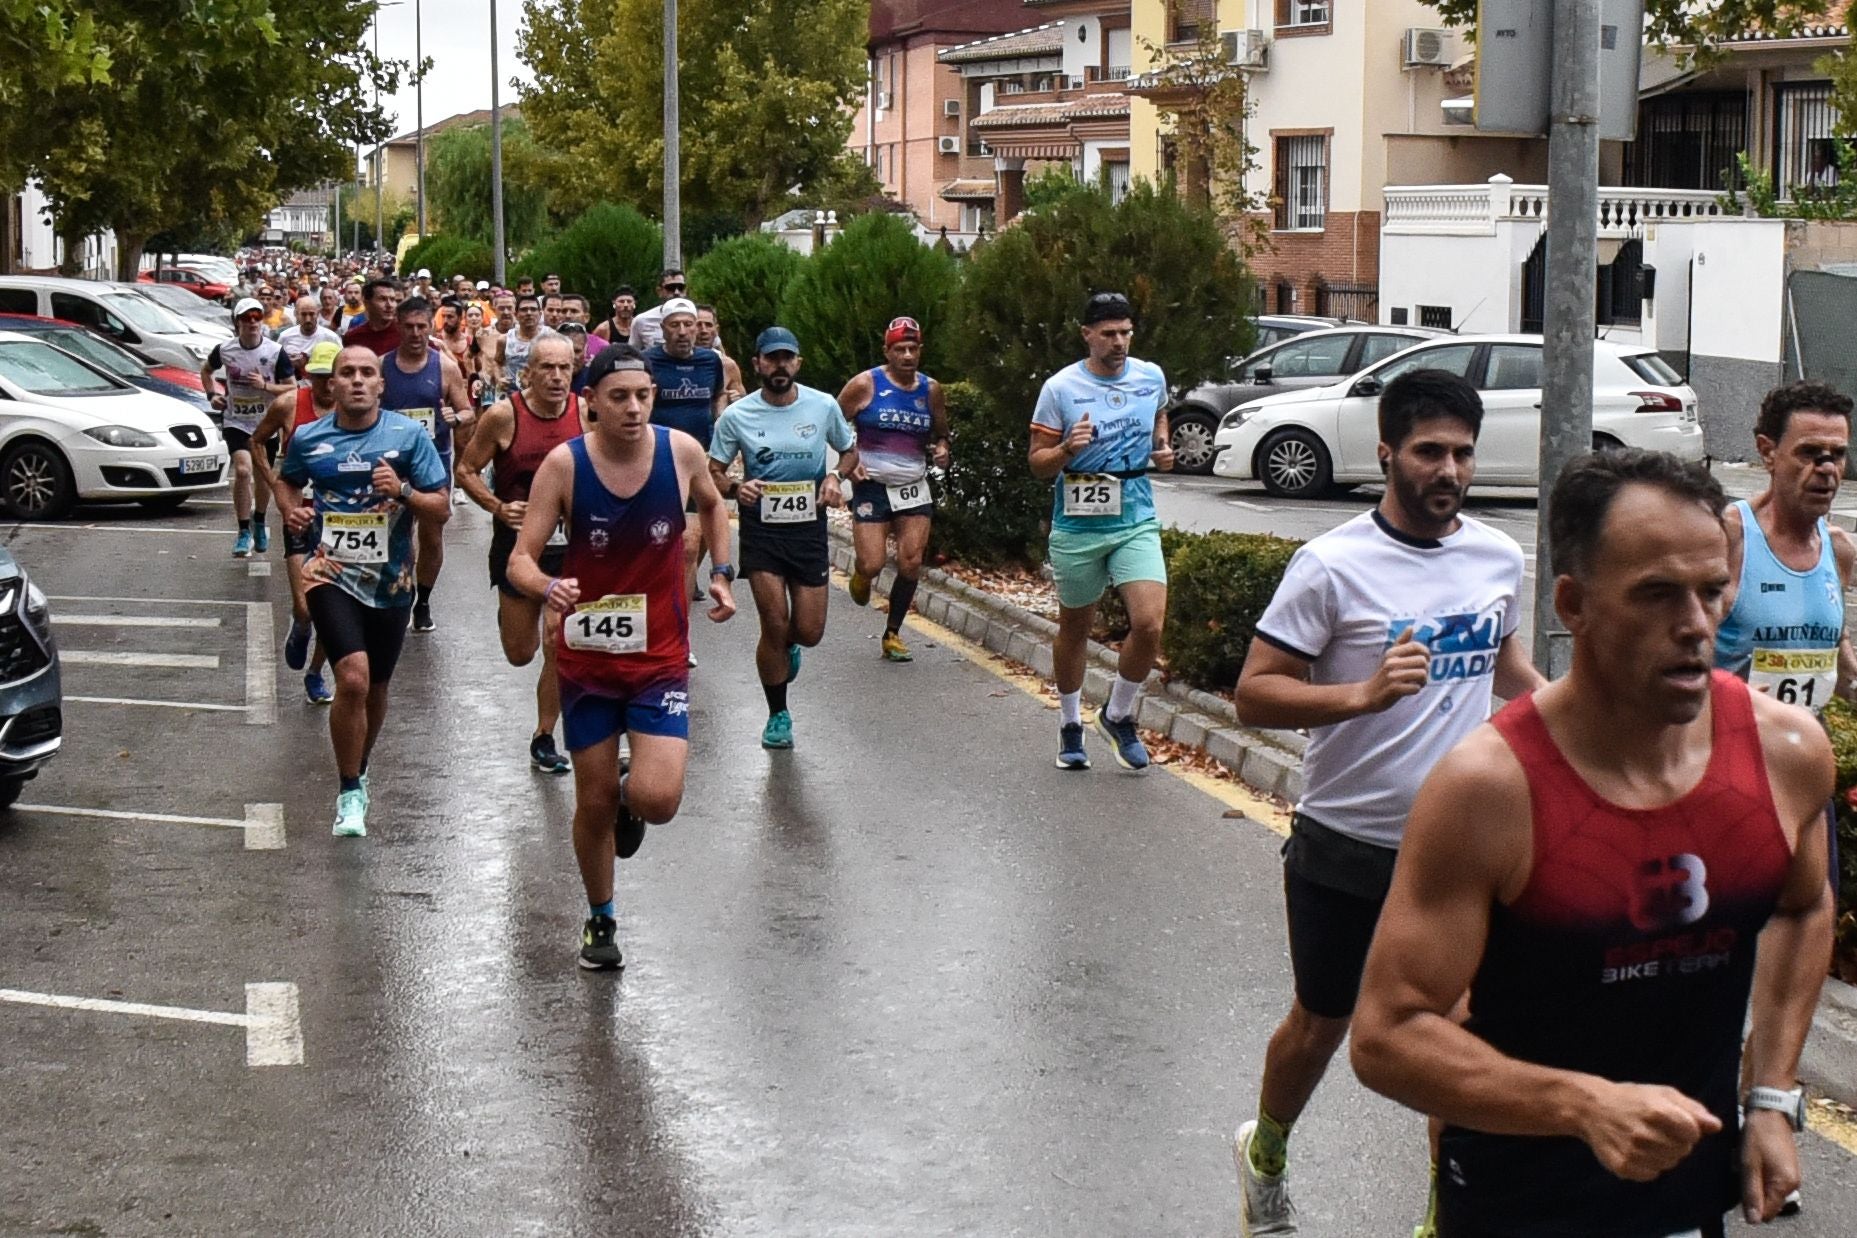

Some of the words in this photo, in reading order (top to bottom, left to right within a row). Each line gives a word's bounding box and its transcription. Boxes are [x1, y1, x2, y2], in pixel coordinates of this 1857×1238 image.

[233, 403, 265, 415] 3249
[900, 485, 919, 501] 60
[1071, 486, 1111, 504] 125
[769, 495, 808, 512] 748
[331, 530, 378, 550] 754
[577, 615, 634, 638] 145
[1430, 653, 1497, 681] UADI
[1776, 677, 1816, 707] 61
[1601, 960, 1659, 984] BIKE
